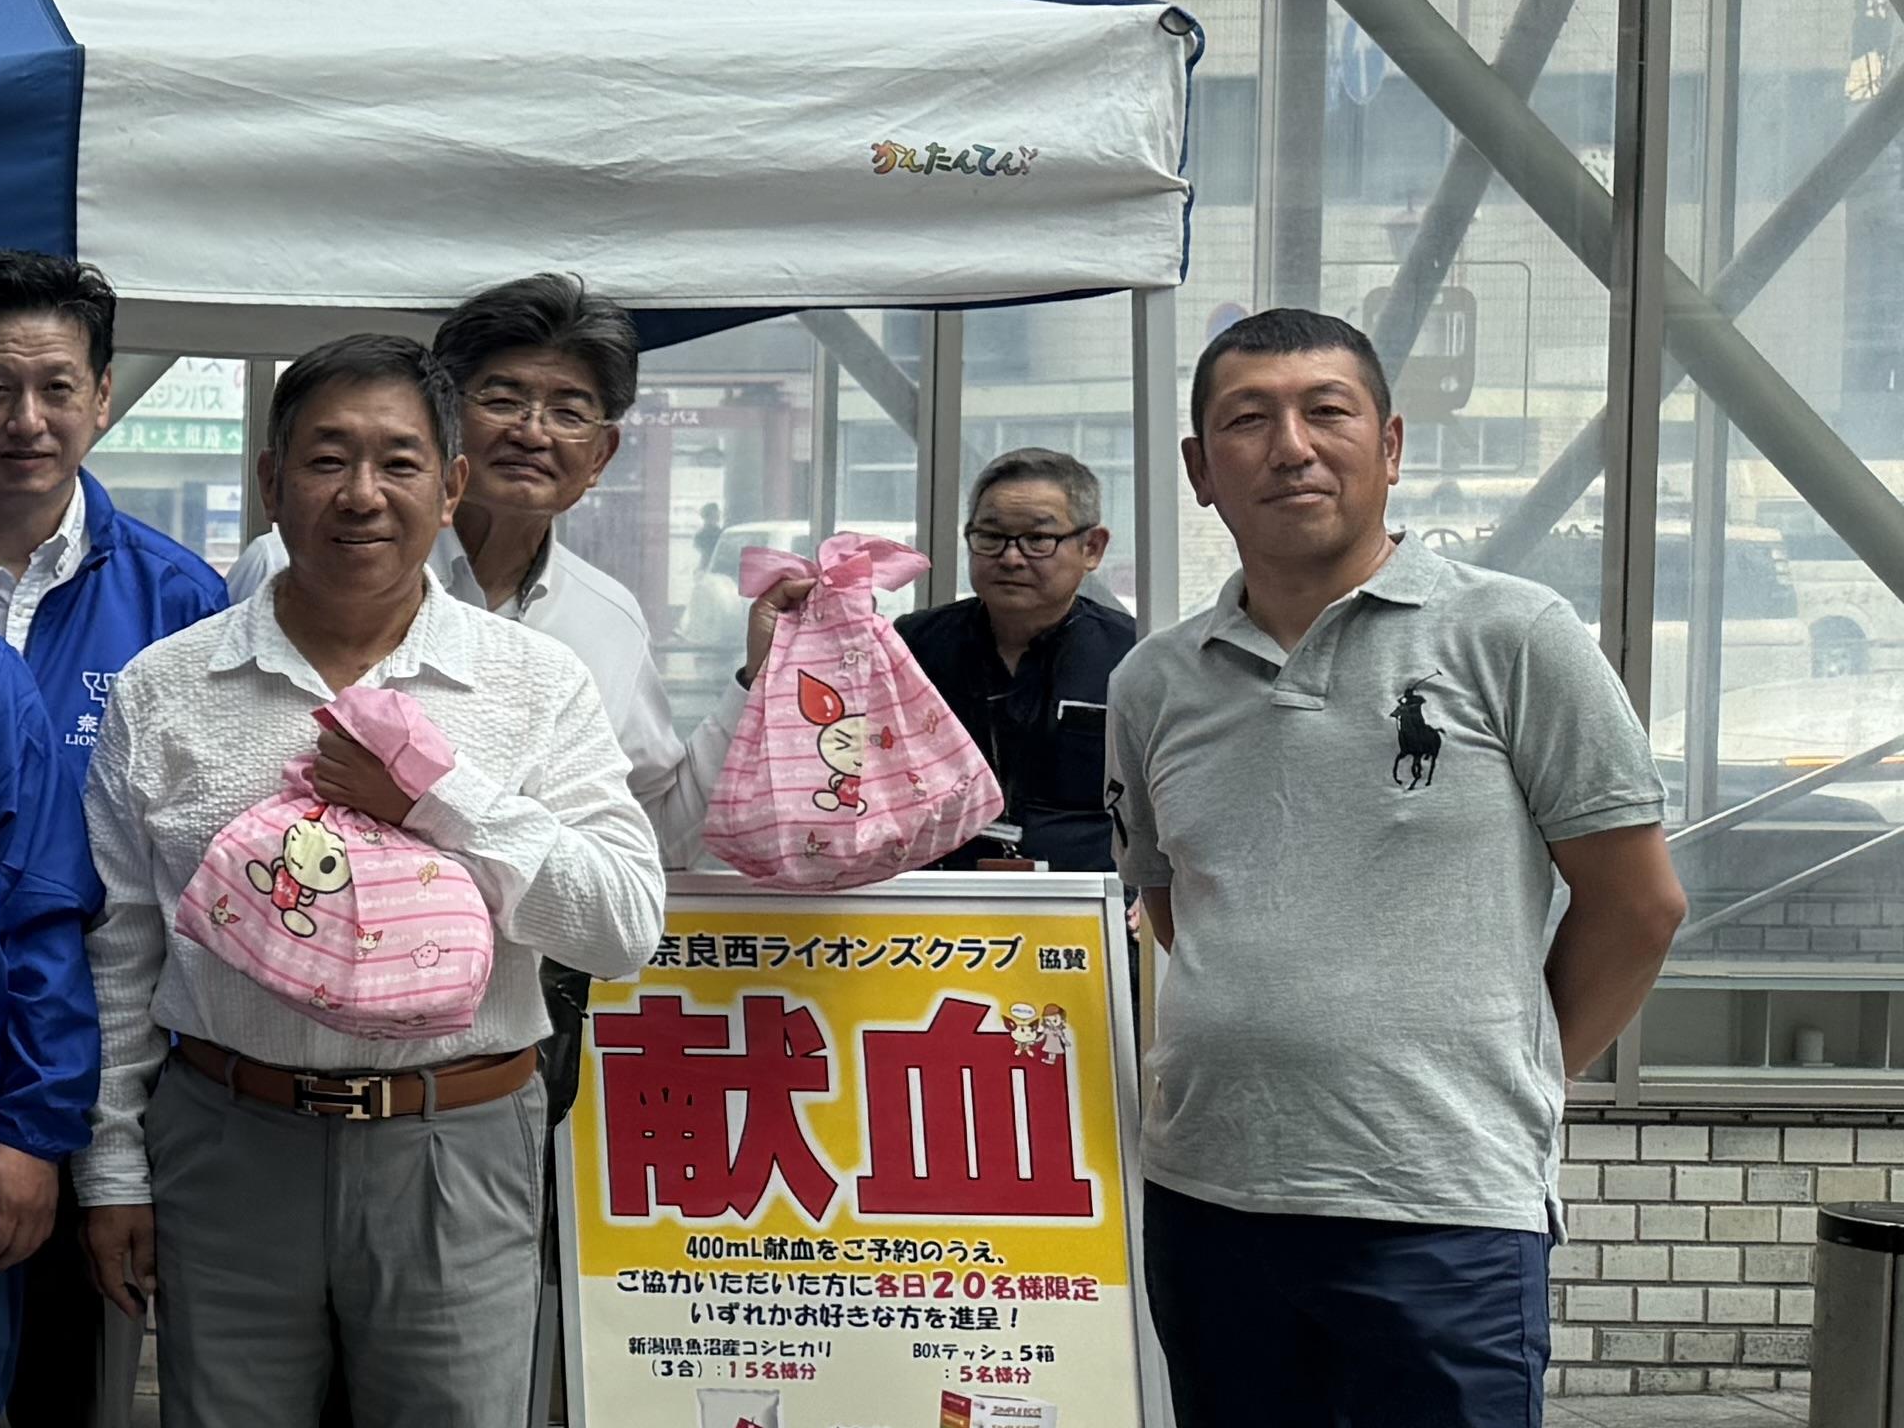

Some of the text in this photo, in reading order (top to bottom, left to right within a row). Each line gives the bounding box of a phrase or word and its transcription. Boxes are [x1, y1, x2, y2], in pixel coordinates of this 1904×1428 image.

[649, 936, 1087, 971] 奈良西ライオンズクラブ 協賛
[593, 994, 1094, 1223] 献血
[686, 1235, 1007, 1265] 400mL献血をご予約のうえ、
[616, 1271, 1099, 1302] ご協力いただいた方に各日20名様限定
[690, 1304, 1018, 1331] いずれかお好きな方を進呈！
[628, 1336, 832, 1358] 新潟県魚沼産コシヒカリ
